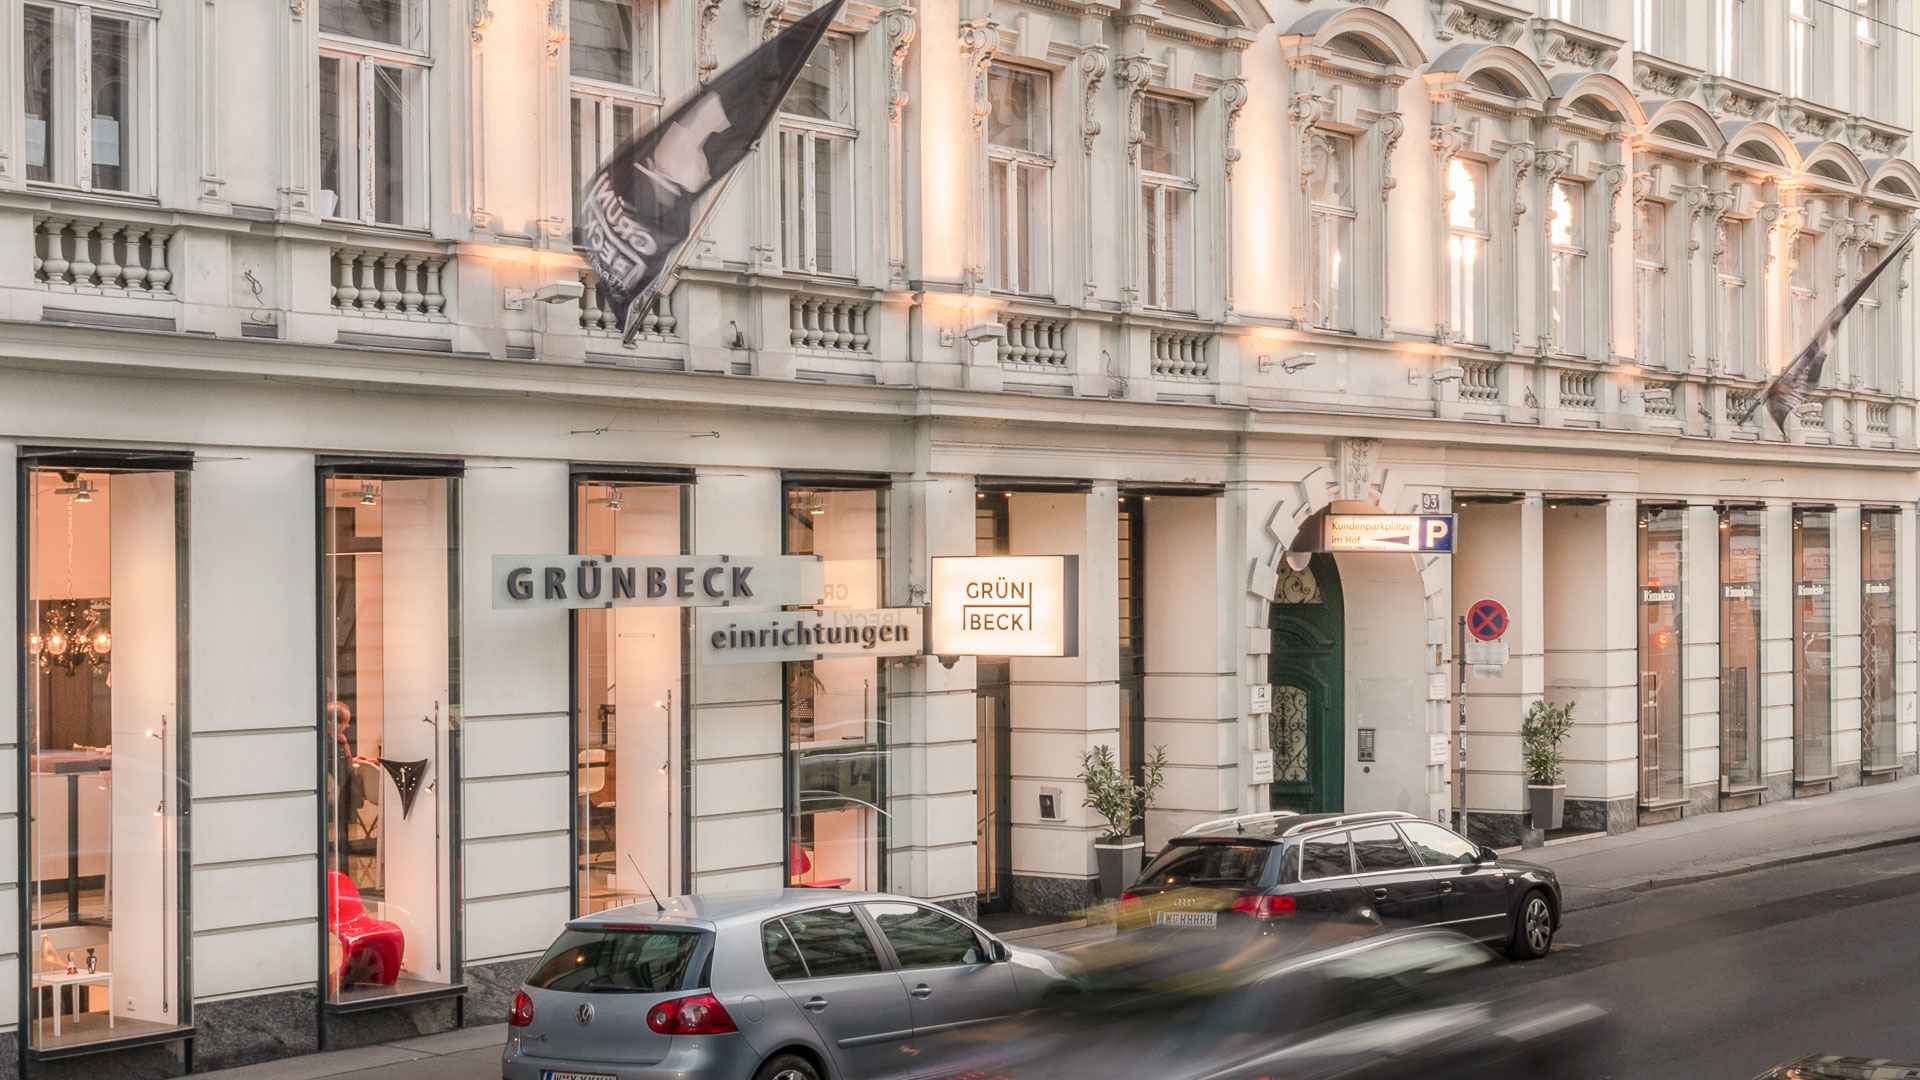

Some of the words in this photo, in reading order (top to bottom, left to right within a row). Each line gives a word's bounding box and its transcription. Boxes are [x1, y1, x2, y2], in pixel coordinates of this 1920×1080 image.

[1424, 495, 1437, 508] 93
[1331, 522, 1412, 532] Kundenparkplätze
[1425, 519, 1448, 548] P
[1331, 535, 1343, 544] im
[1345, 535, 1361, 544] Hof
[507, 559, 754, 600] GRÜNBECK
[966, 577, 1025, 599] GRÜN
[969, 613, 1024, 631] BECK
[711, 620, 910, 650] einrichtungen
